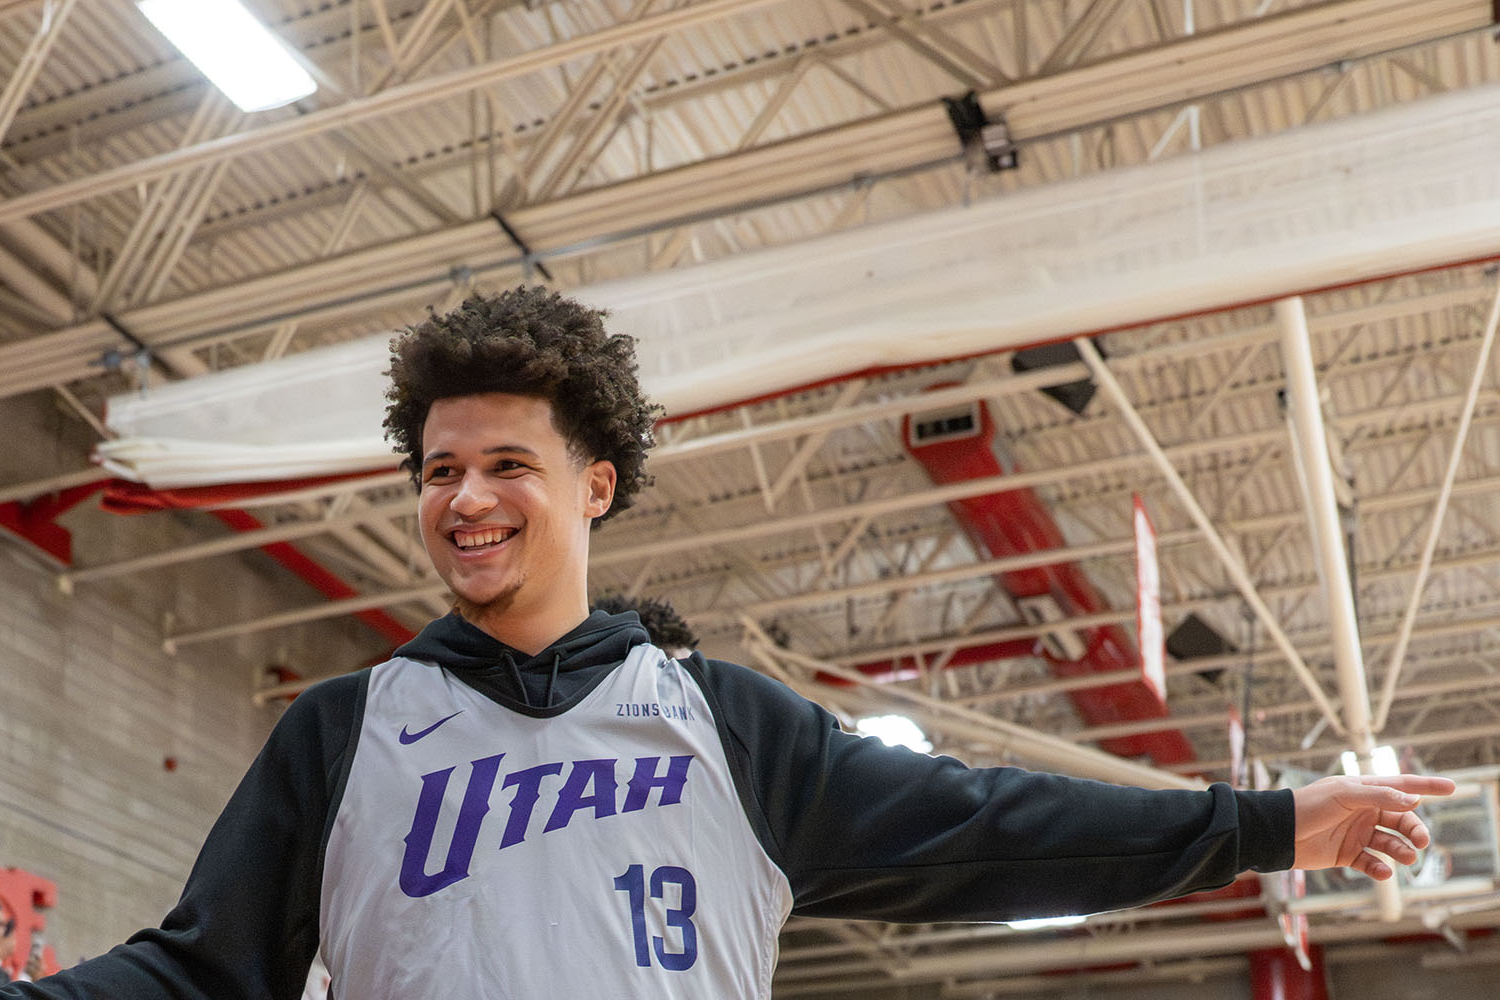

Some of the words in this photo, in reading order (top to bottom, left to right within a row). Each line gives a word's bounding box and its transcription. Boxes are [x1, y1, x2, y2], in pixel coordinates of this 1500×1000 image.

[616, 703, 660, 717] ZIONS
[661, 704, 695, 721] BANK
[399, 752, 694, 898] UTAH
[613, 863, 698, 972] 13
